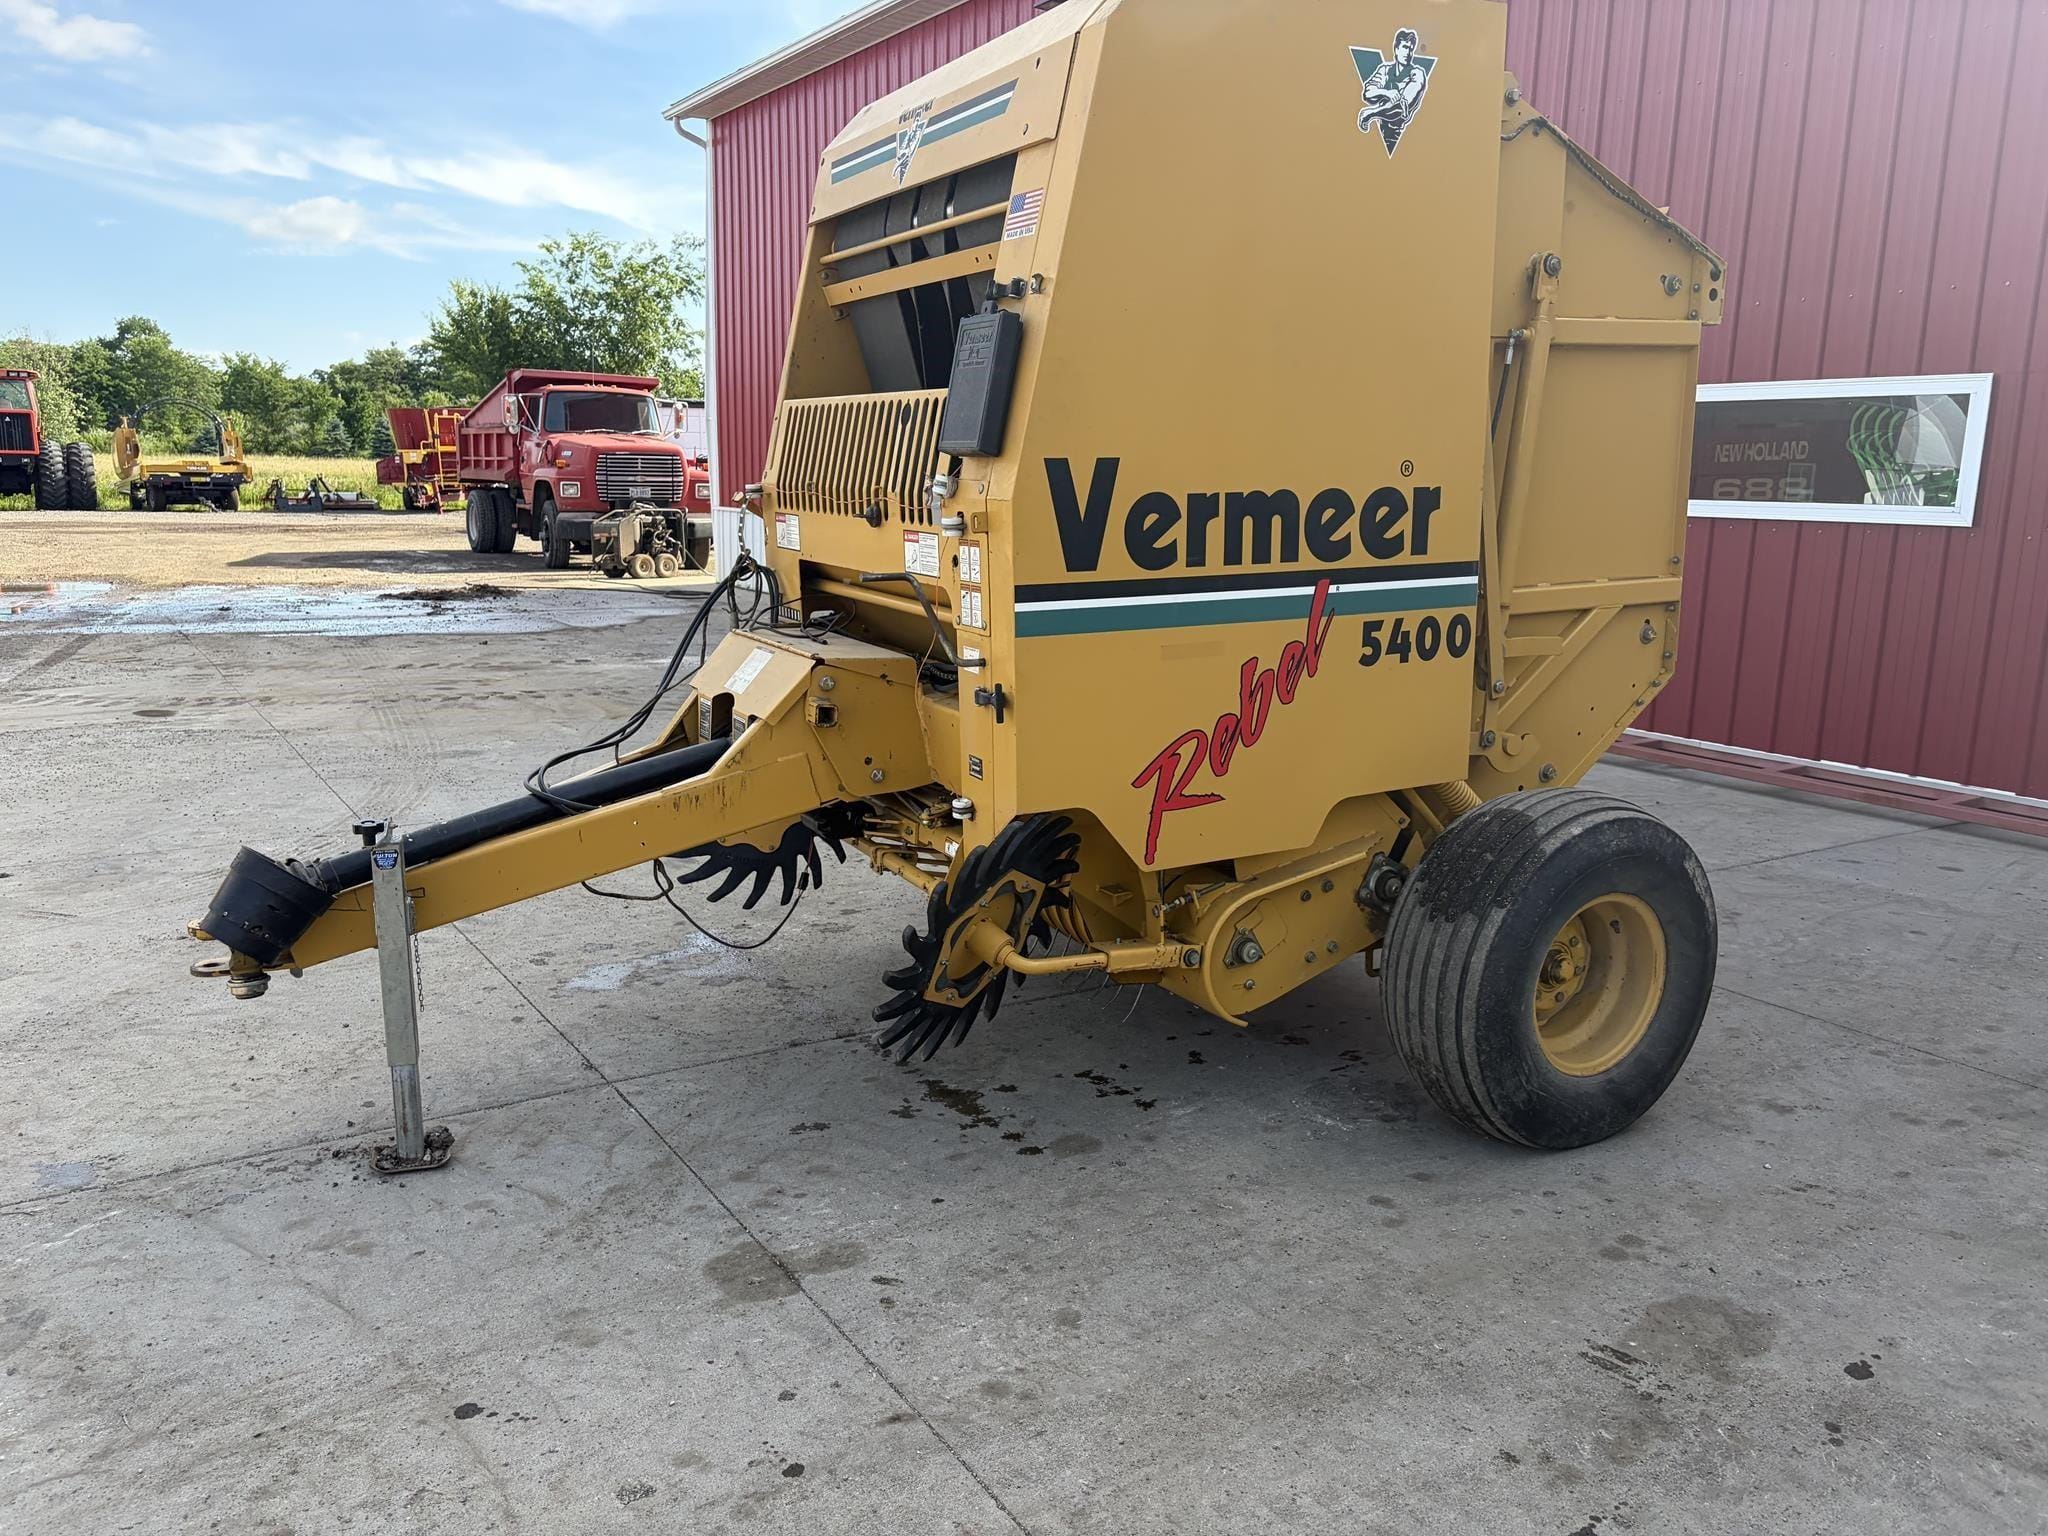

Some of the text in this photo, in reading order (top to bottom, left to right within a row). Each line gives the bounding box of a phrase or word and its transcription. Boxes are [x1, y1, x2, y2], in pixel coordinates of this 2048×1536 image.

[1714, 440, 1809, 463] NEW HOLLAND
[1043, 456, 1442, 573] Vermeer
[1713, 477, 1808, 501] 688
[1358, 612, 1472, 667] 5400
[1131, 579, 1335, 866] Rebel
